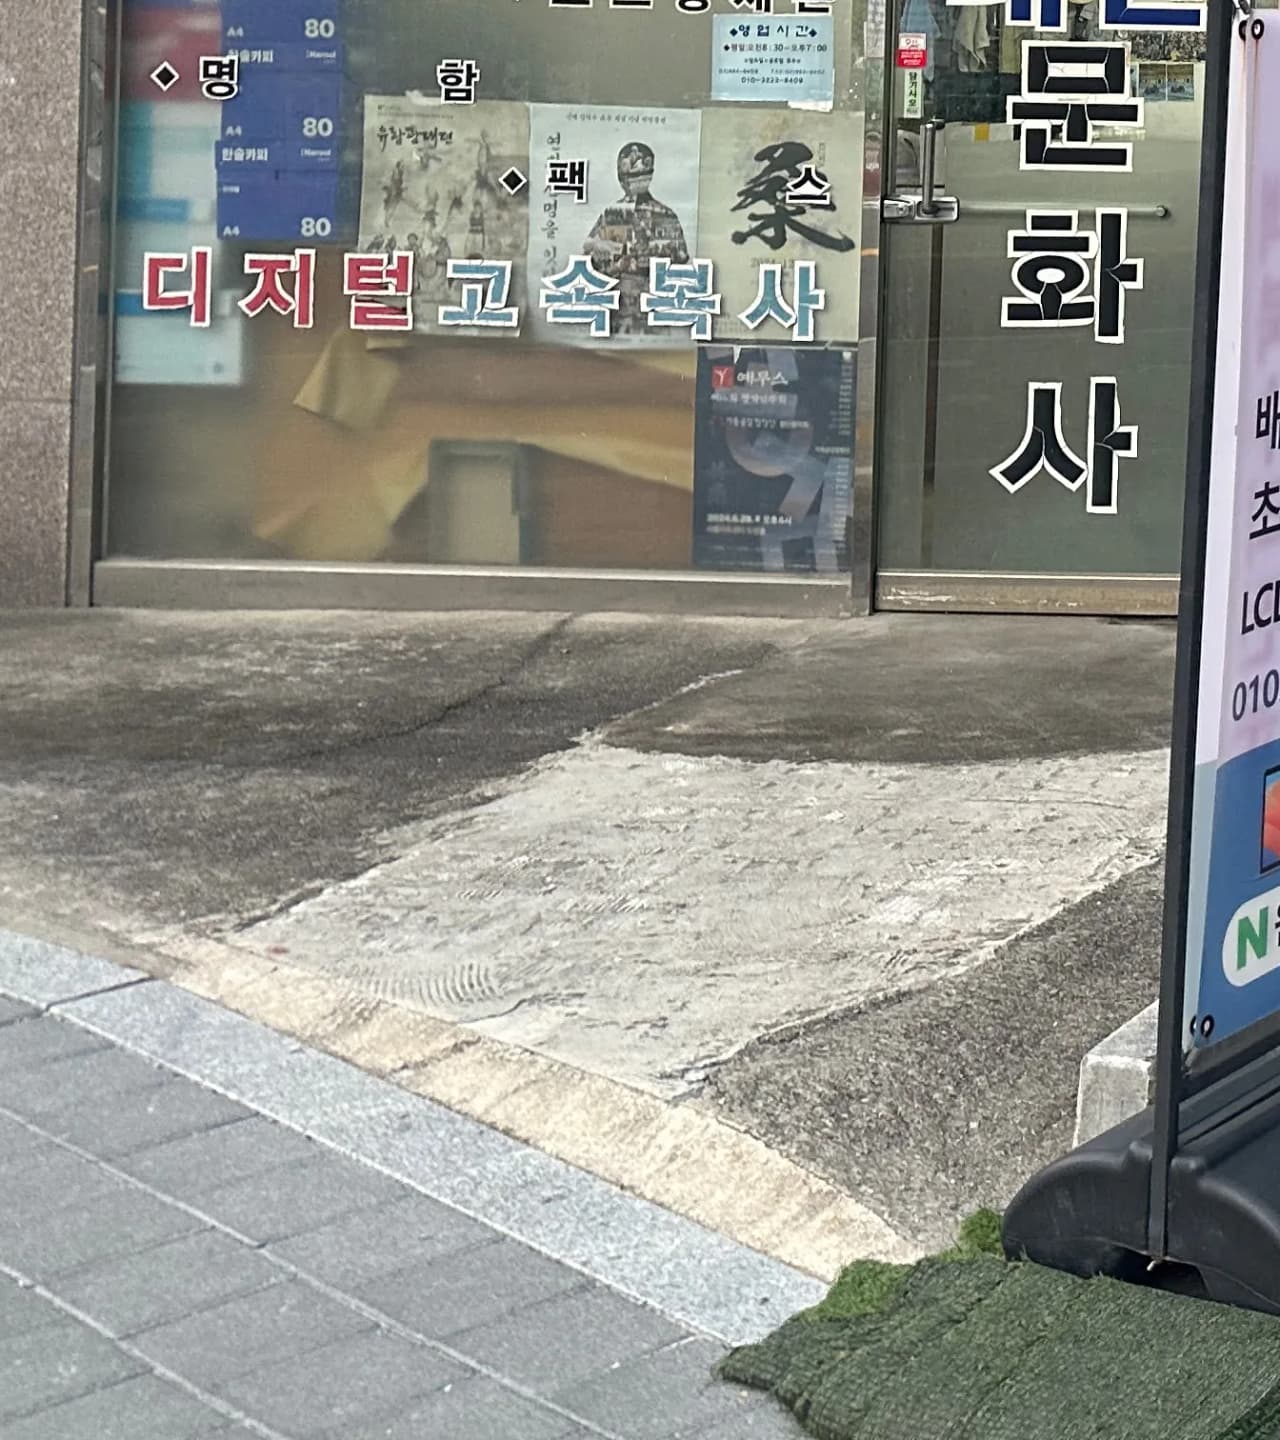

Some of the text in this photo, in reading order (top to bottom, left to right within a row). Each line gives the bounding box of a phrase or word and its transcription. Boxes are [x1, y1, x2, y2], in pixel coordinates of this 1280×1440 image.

[305, 19, 335, 38] 80
[303, 117, 333, 137] 80
[301, 217, 331, 237] 80
